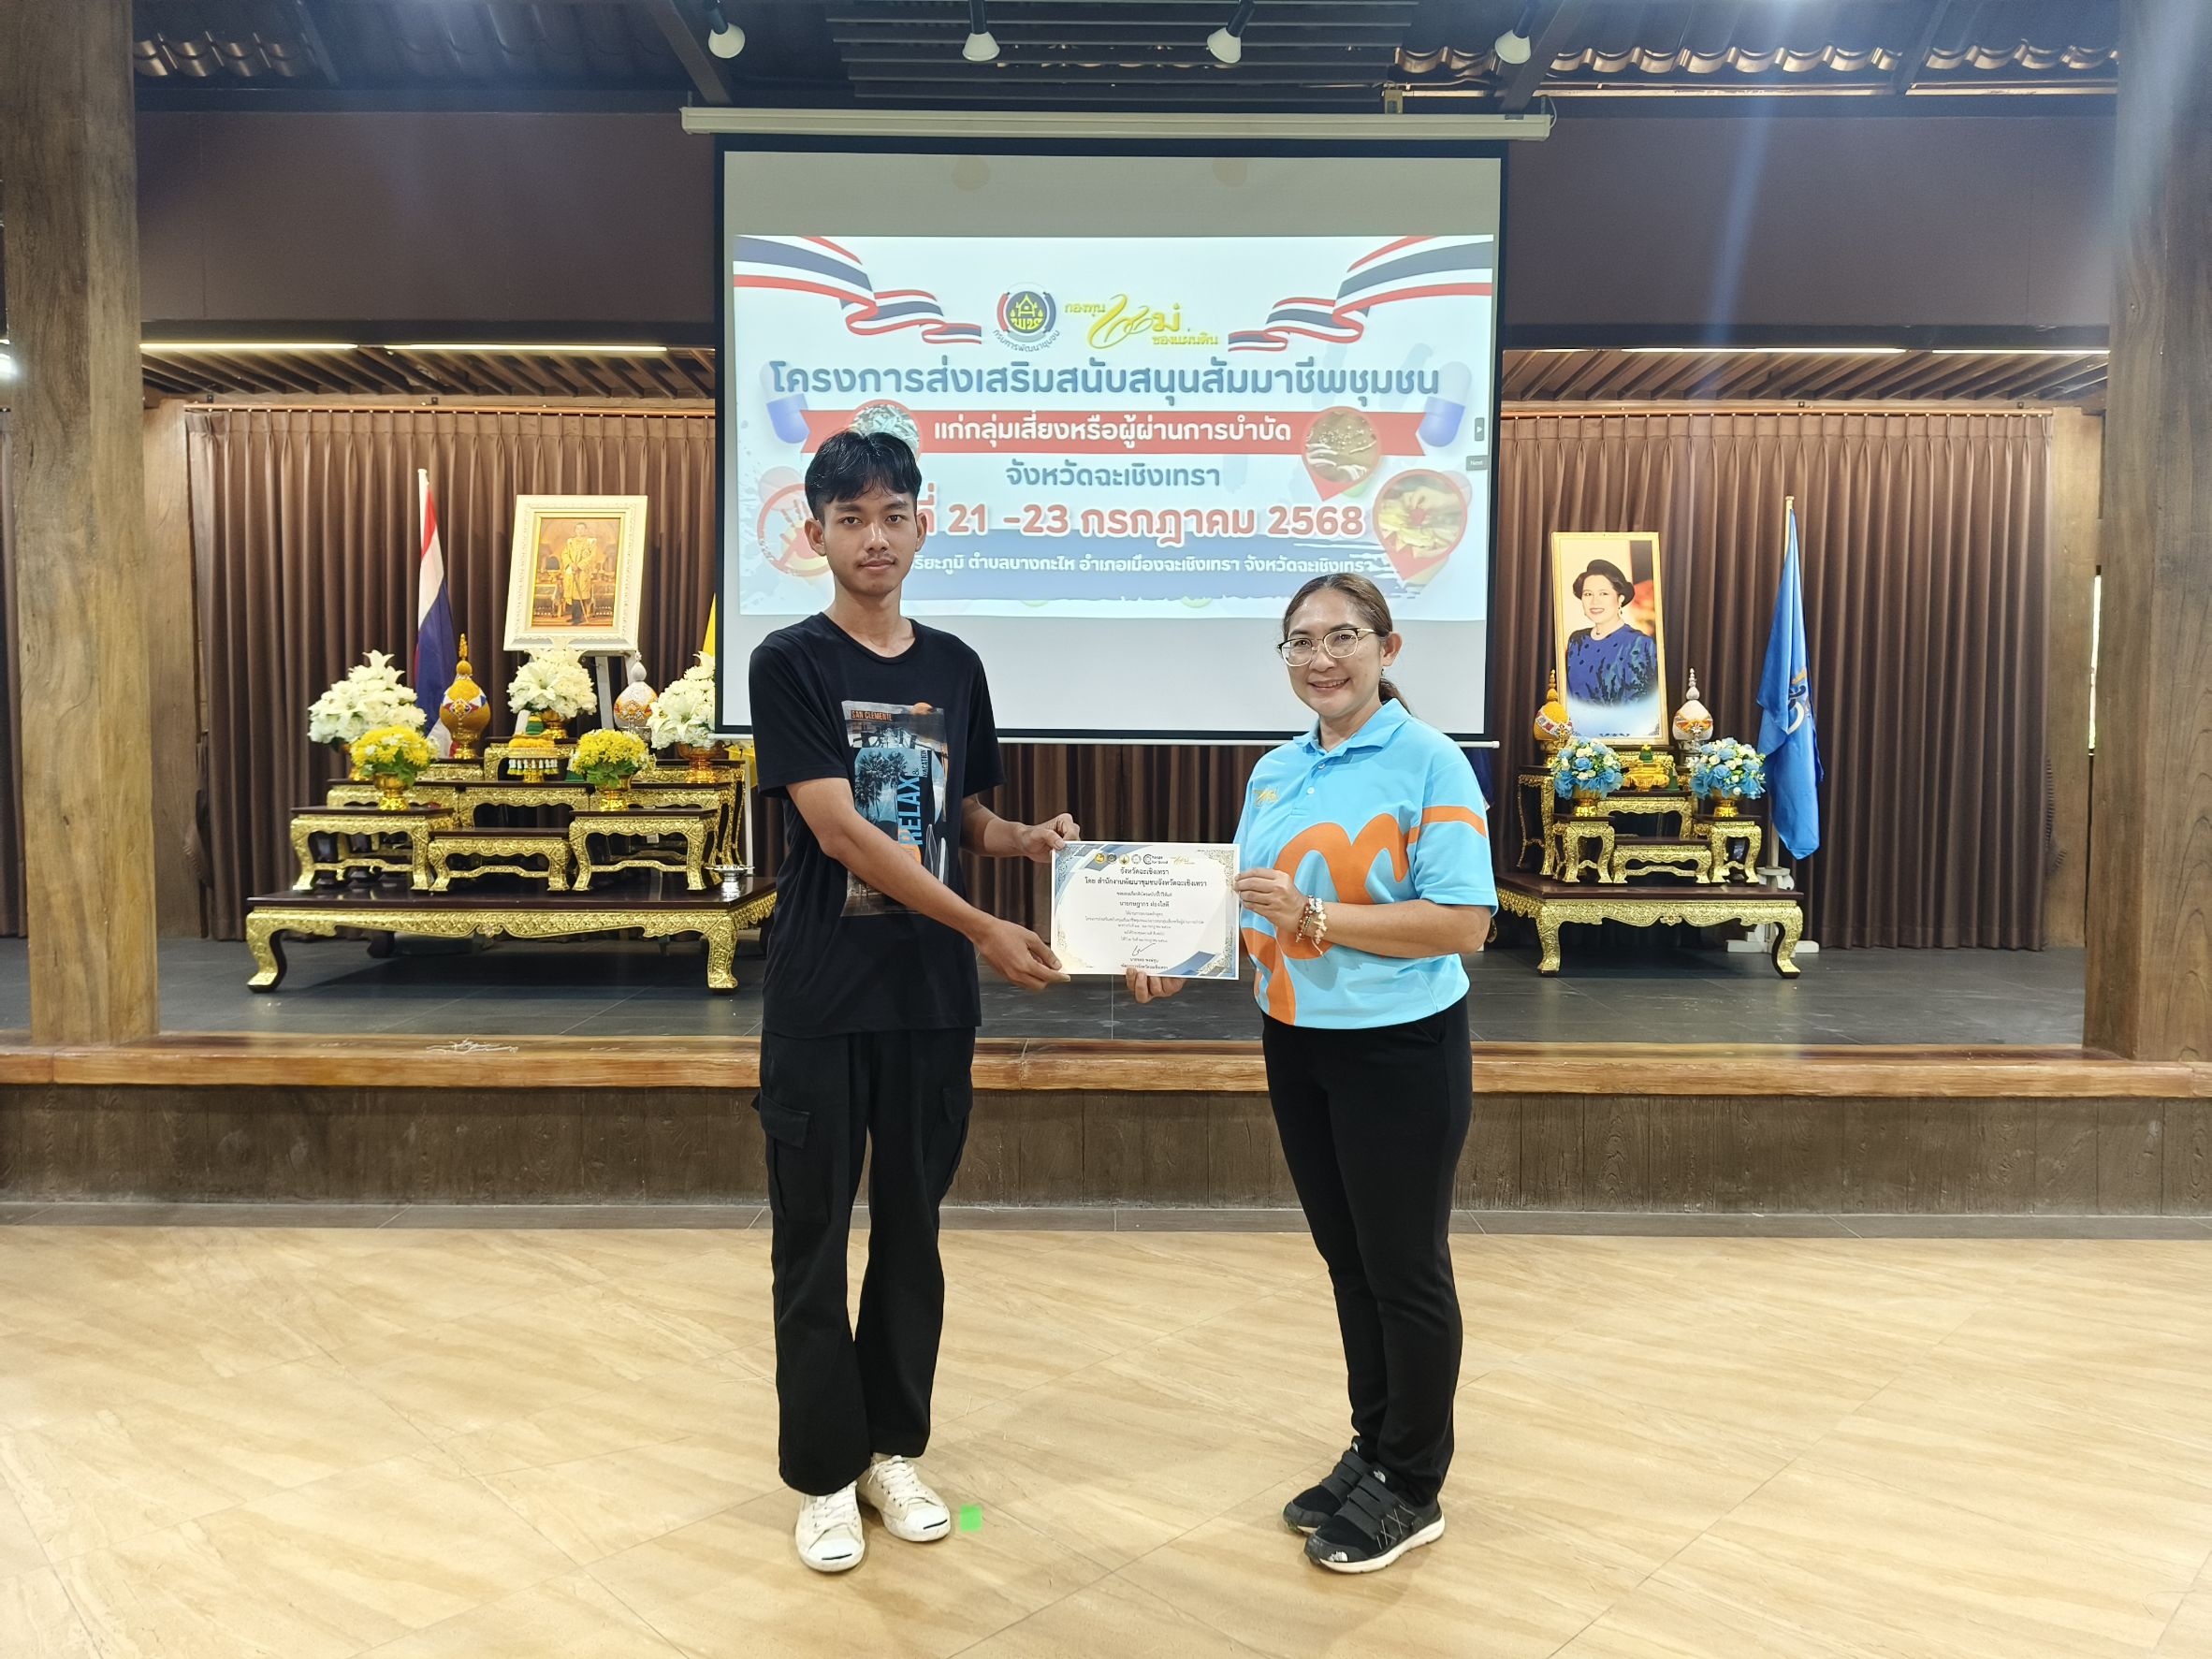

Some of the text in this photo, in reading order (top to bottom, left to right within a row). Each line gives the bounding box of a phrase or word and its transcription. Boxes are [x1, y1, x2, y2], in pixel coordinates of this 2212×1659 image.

[770, 356, 1440, 406] โครงการส่งเสริมสนับสนุนสัมมาชีพชุมชน
[934, 410, 1291, 448] แก่กลุ่มเสี่ยงหรือผู้ผ่านการบำบัด
[1005, 458, 1221, 488] จังหวัดฉะเชิงเทรา
[948, 503, 986, 533] 21
[1080, 508, 1255, 545] กรกฎาคม
[1267, 505, 1364, 535] 2568
[913, 551, 1373, 575] ริยะภูมิ ตำบลบางกะไห อำเภอเมืองฉะเชิงเทรา จังหวัดฉะเชิงเทรา
[897, 775, 924, 846] RELAX
